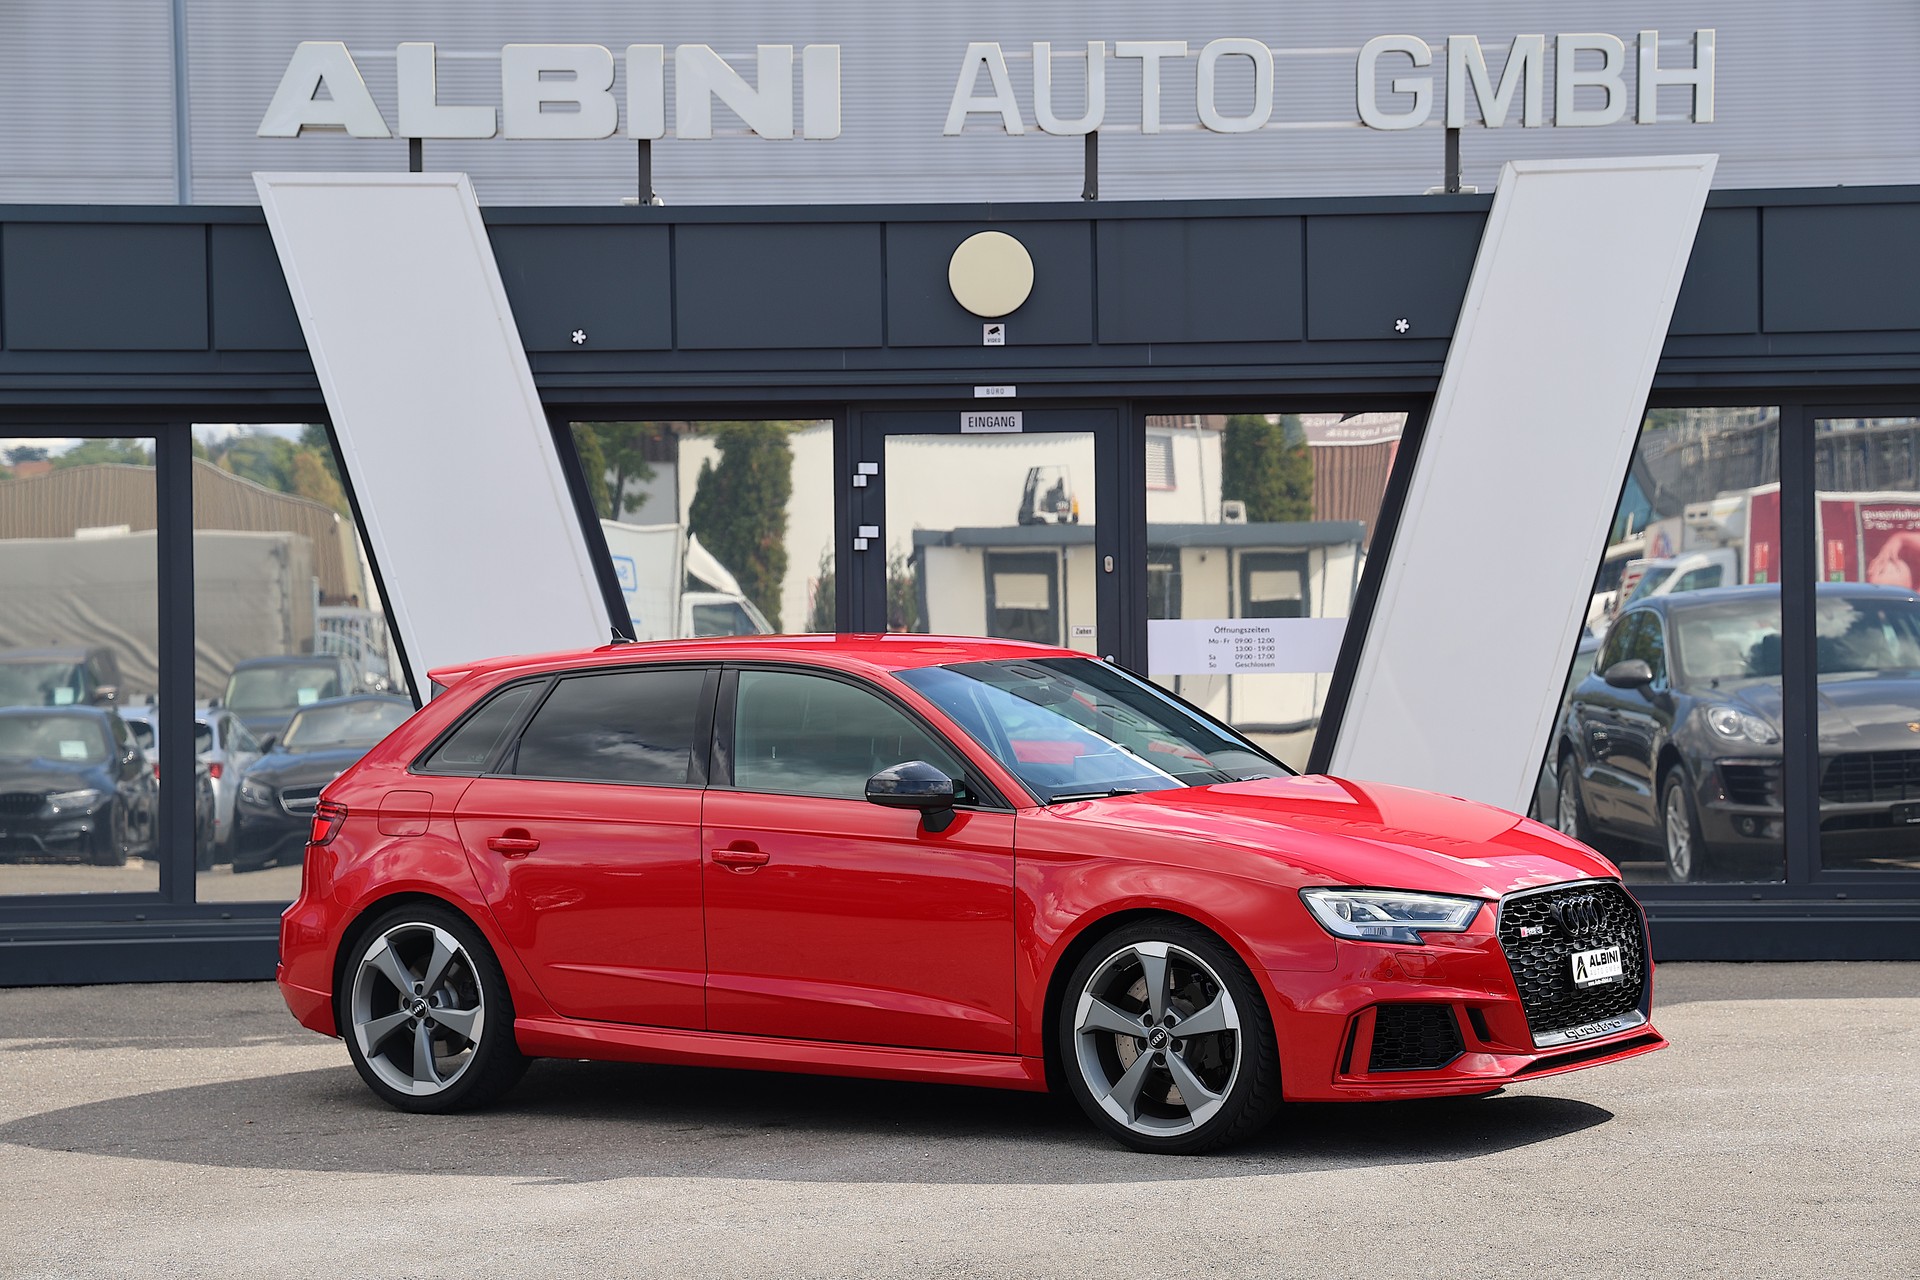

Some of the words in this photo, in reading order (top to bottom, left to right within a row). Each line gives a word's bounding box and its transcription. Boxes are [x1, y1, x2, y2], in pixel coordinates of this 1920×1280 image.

[256, 41, 841, 140] ALBINI
[943, 38, 1275, 136] AUTO
[1356, 28, 1716, 131] GMBH
[968, 416, 1016, 428] EINGANG
[1214, 626, 1271, 635] Öffnungszeiten
[1590, 950, 1619, 968] ALBINI
[1565, 1019, 1622, 1039] quattro
